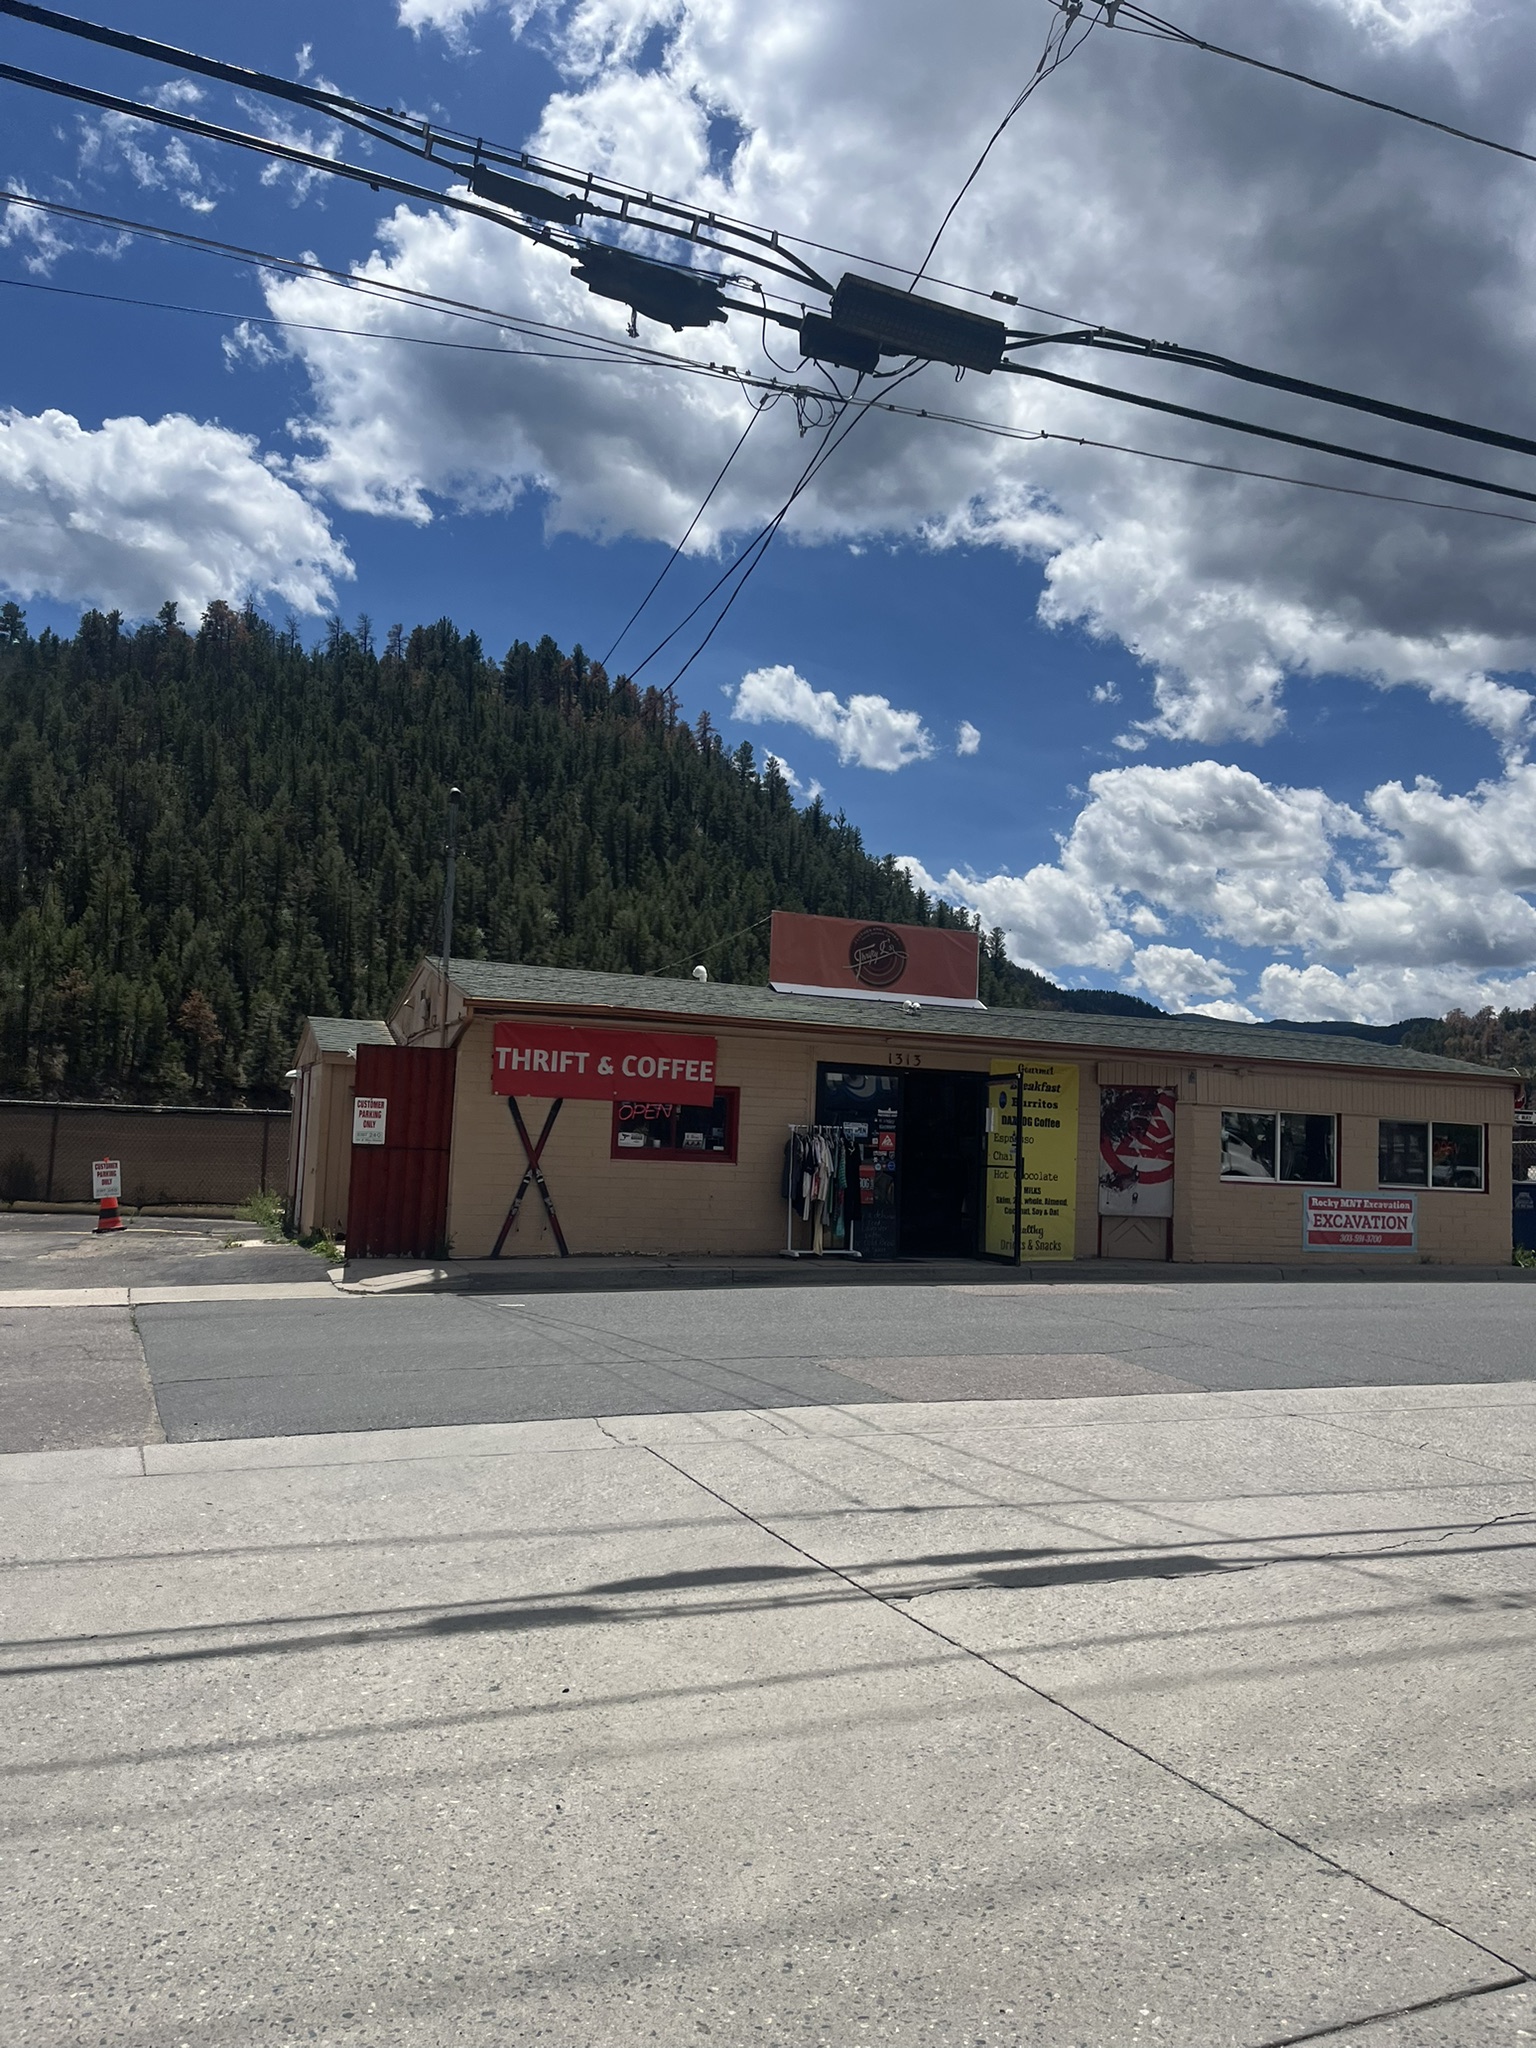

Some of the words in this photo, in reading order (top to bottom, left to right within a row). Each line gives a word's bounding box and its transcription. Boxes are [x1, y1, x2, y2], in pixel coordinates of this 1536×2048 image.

[495, 1046, 590, 1074] THRIFT
[597, 1056, 614, 1076] &
[622, 1055, 713, 1082] COFFEE
[888, 1053, 922, 1066] 1313
[1018, 1063, 1054, 1075] Gourmet
[1010, 1080, 1061, 1093] Beakfast
[357, 1100, 384, 1109] CUSTOMER
[359, 1110, 382, 1119] PARKING
[618, 1103, 673, 1121] OPEN
[363, 1120, 376, 1128] ONLY
[1001, 1115, 1032, 1126] DAZOG
[1034, 1117, 1061, 1128] Coffee
[993, 1150, 1013, 1161] Chai
[993, 1169, 1009, 1179] Hot
[1024, 1186, 1042, 1195] MILKS
[1311, 1197, 1339, 1209] Rocky
[1340, 1198, 1363, 1208] MNT
[1364, 1199, 1410, 1210] Excavation
[1032, 1207, 1043, 1216] Soy
[1313, 1213, 1408, 1230] EXCAVATION
[1027, 1239, 1033, 1250] &
[1035, 1239, 1062, 1251] Snacks
